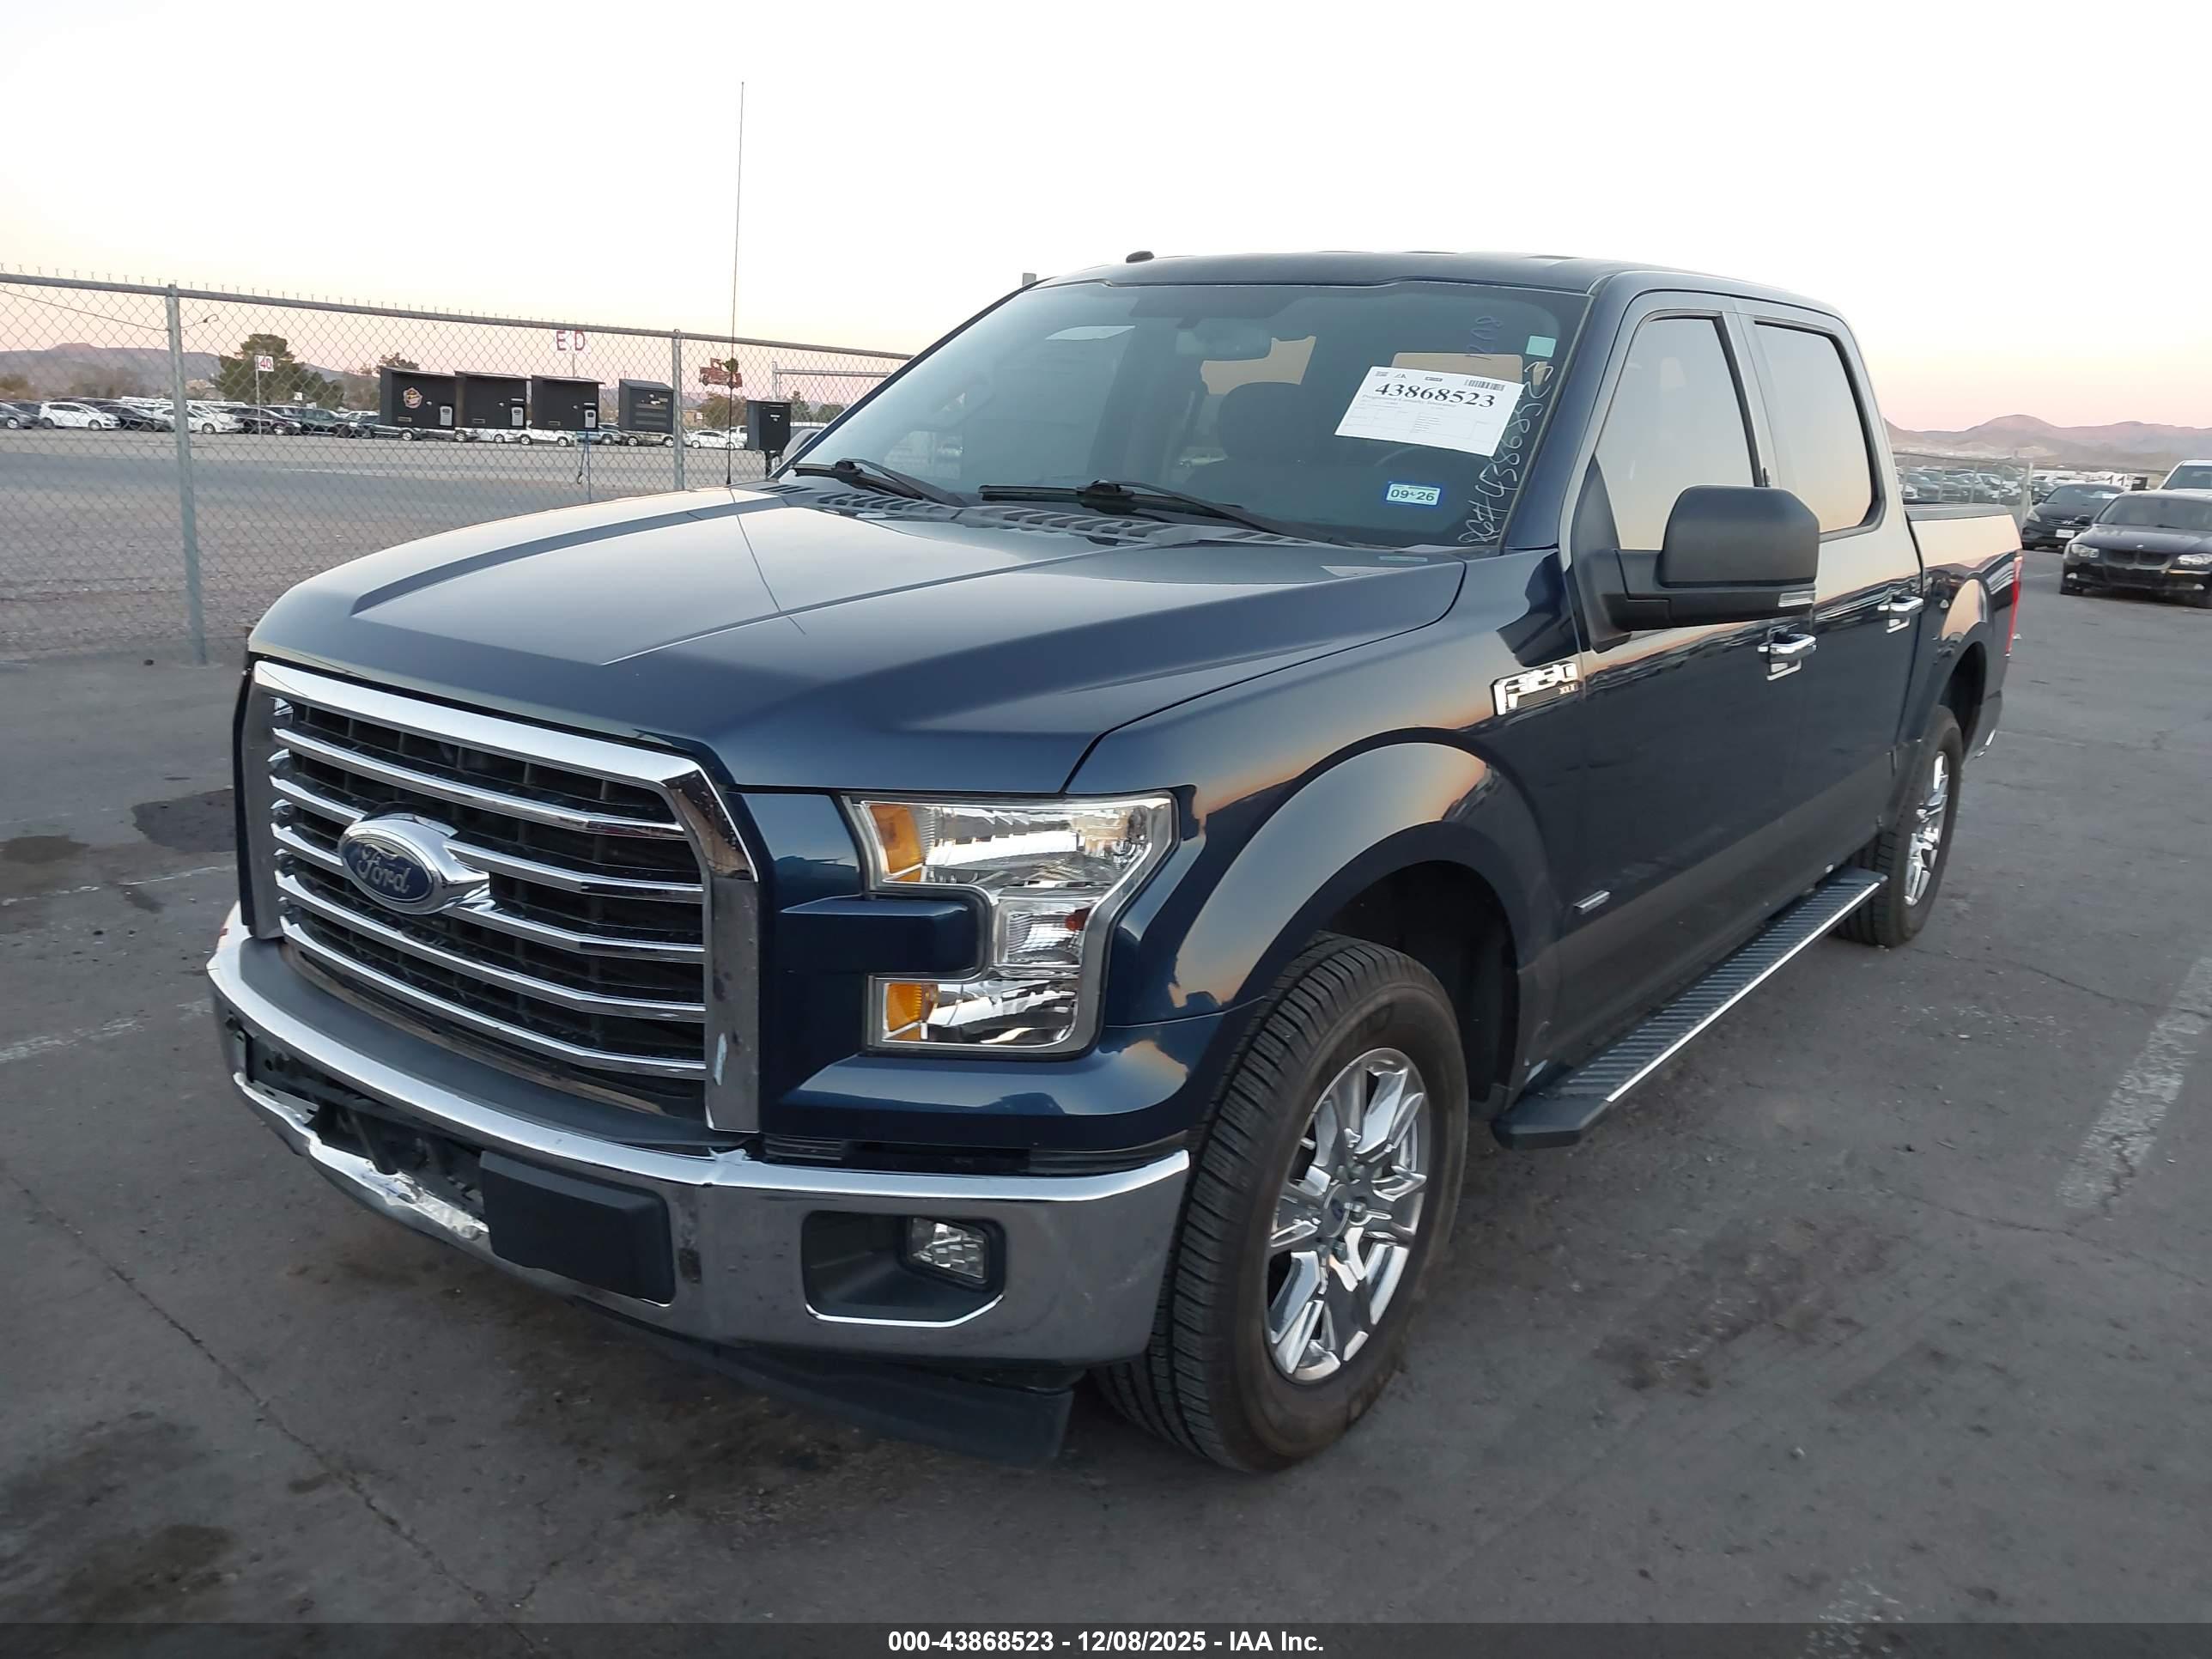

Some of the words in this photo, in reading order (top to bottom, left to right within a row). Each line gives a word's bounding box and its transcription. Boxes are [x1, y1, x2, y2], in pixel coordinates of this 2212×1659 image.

[1375, 383, 1496, 408] 43868523
[1391, 489, 1409, 499] 09
[1415, 491, 1436, 501] 26
[356, 844, 412, 894] Ford
